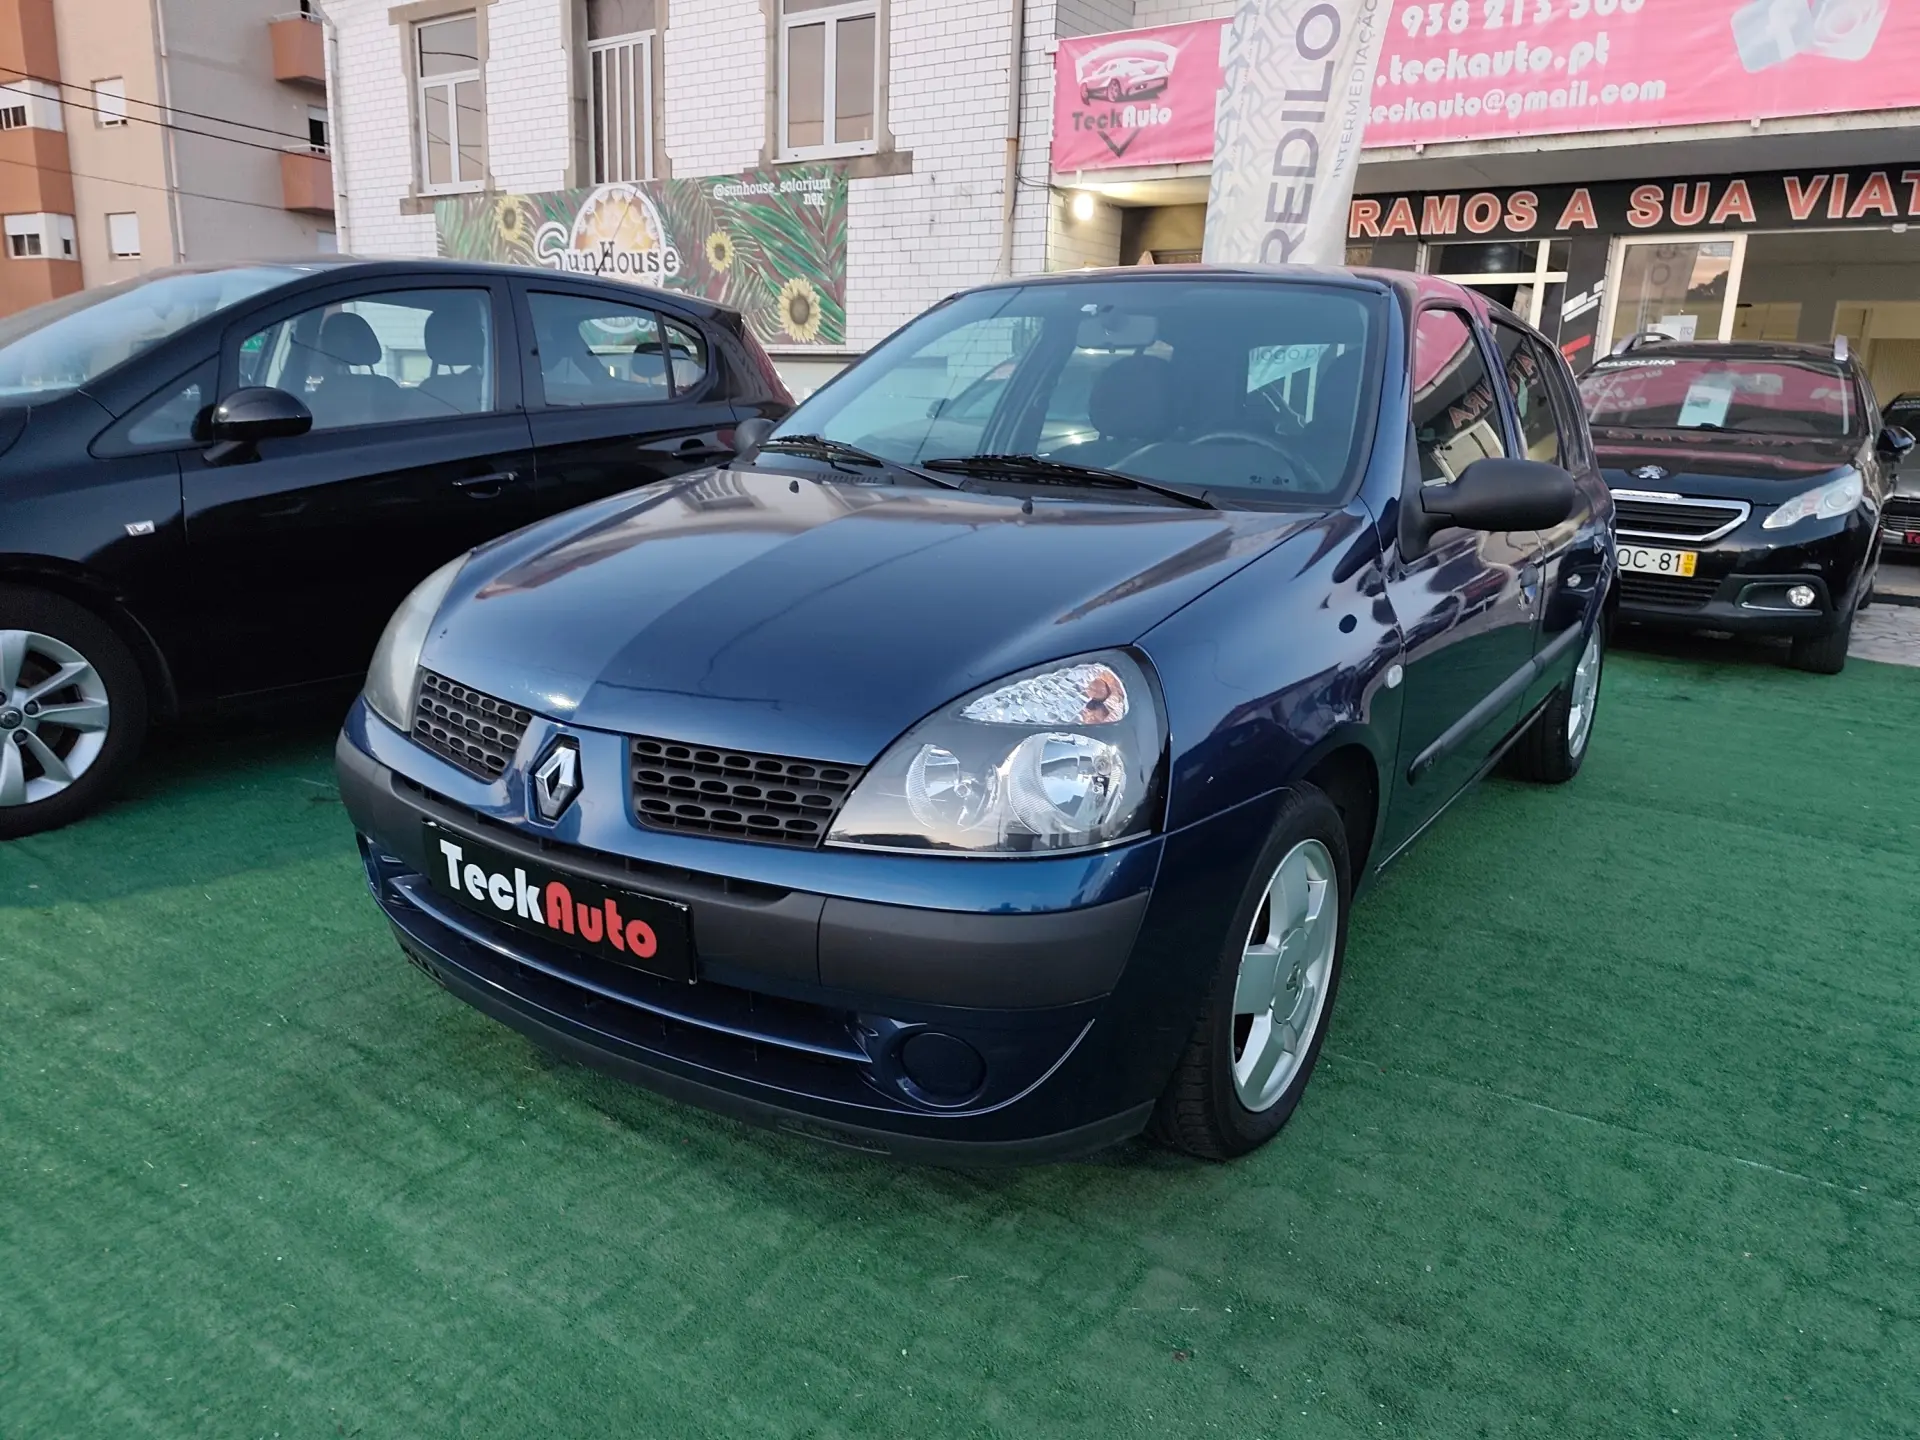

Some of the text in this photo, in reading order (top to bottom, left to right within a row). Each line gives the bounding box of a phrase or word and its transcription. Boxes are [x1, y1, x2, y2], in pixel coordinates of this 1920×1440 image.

[1402, 0, 1469, 36] 938
[1072, 104, 1172, 130] TeckAuto
[1349, 190, 1538, 238] RAMOS
[1555, 188, 1598, 230] A
[1627, 180, 1756, 228] SUA
[1597, 360, 1675, 368] GASOLINA
[440, 839, 657, 958] TeckAuto
